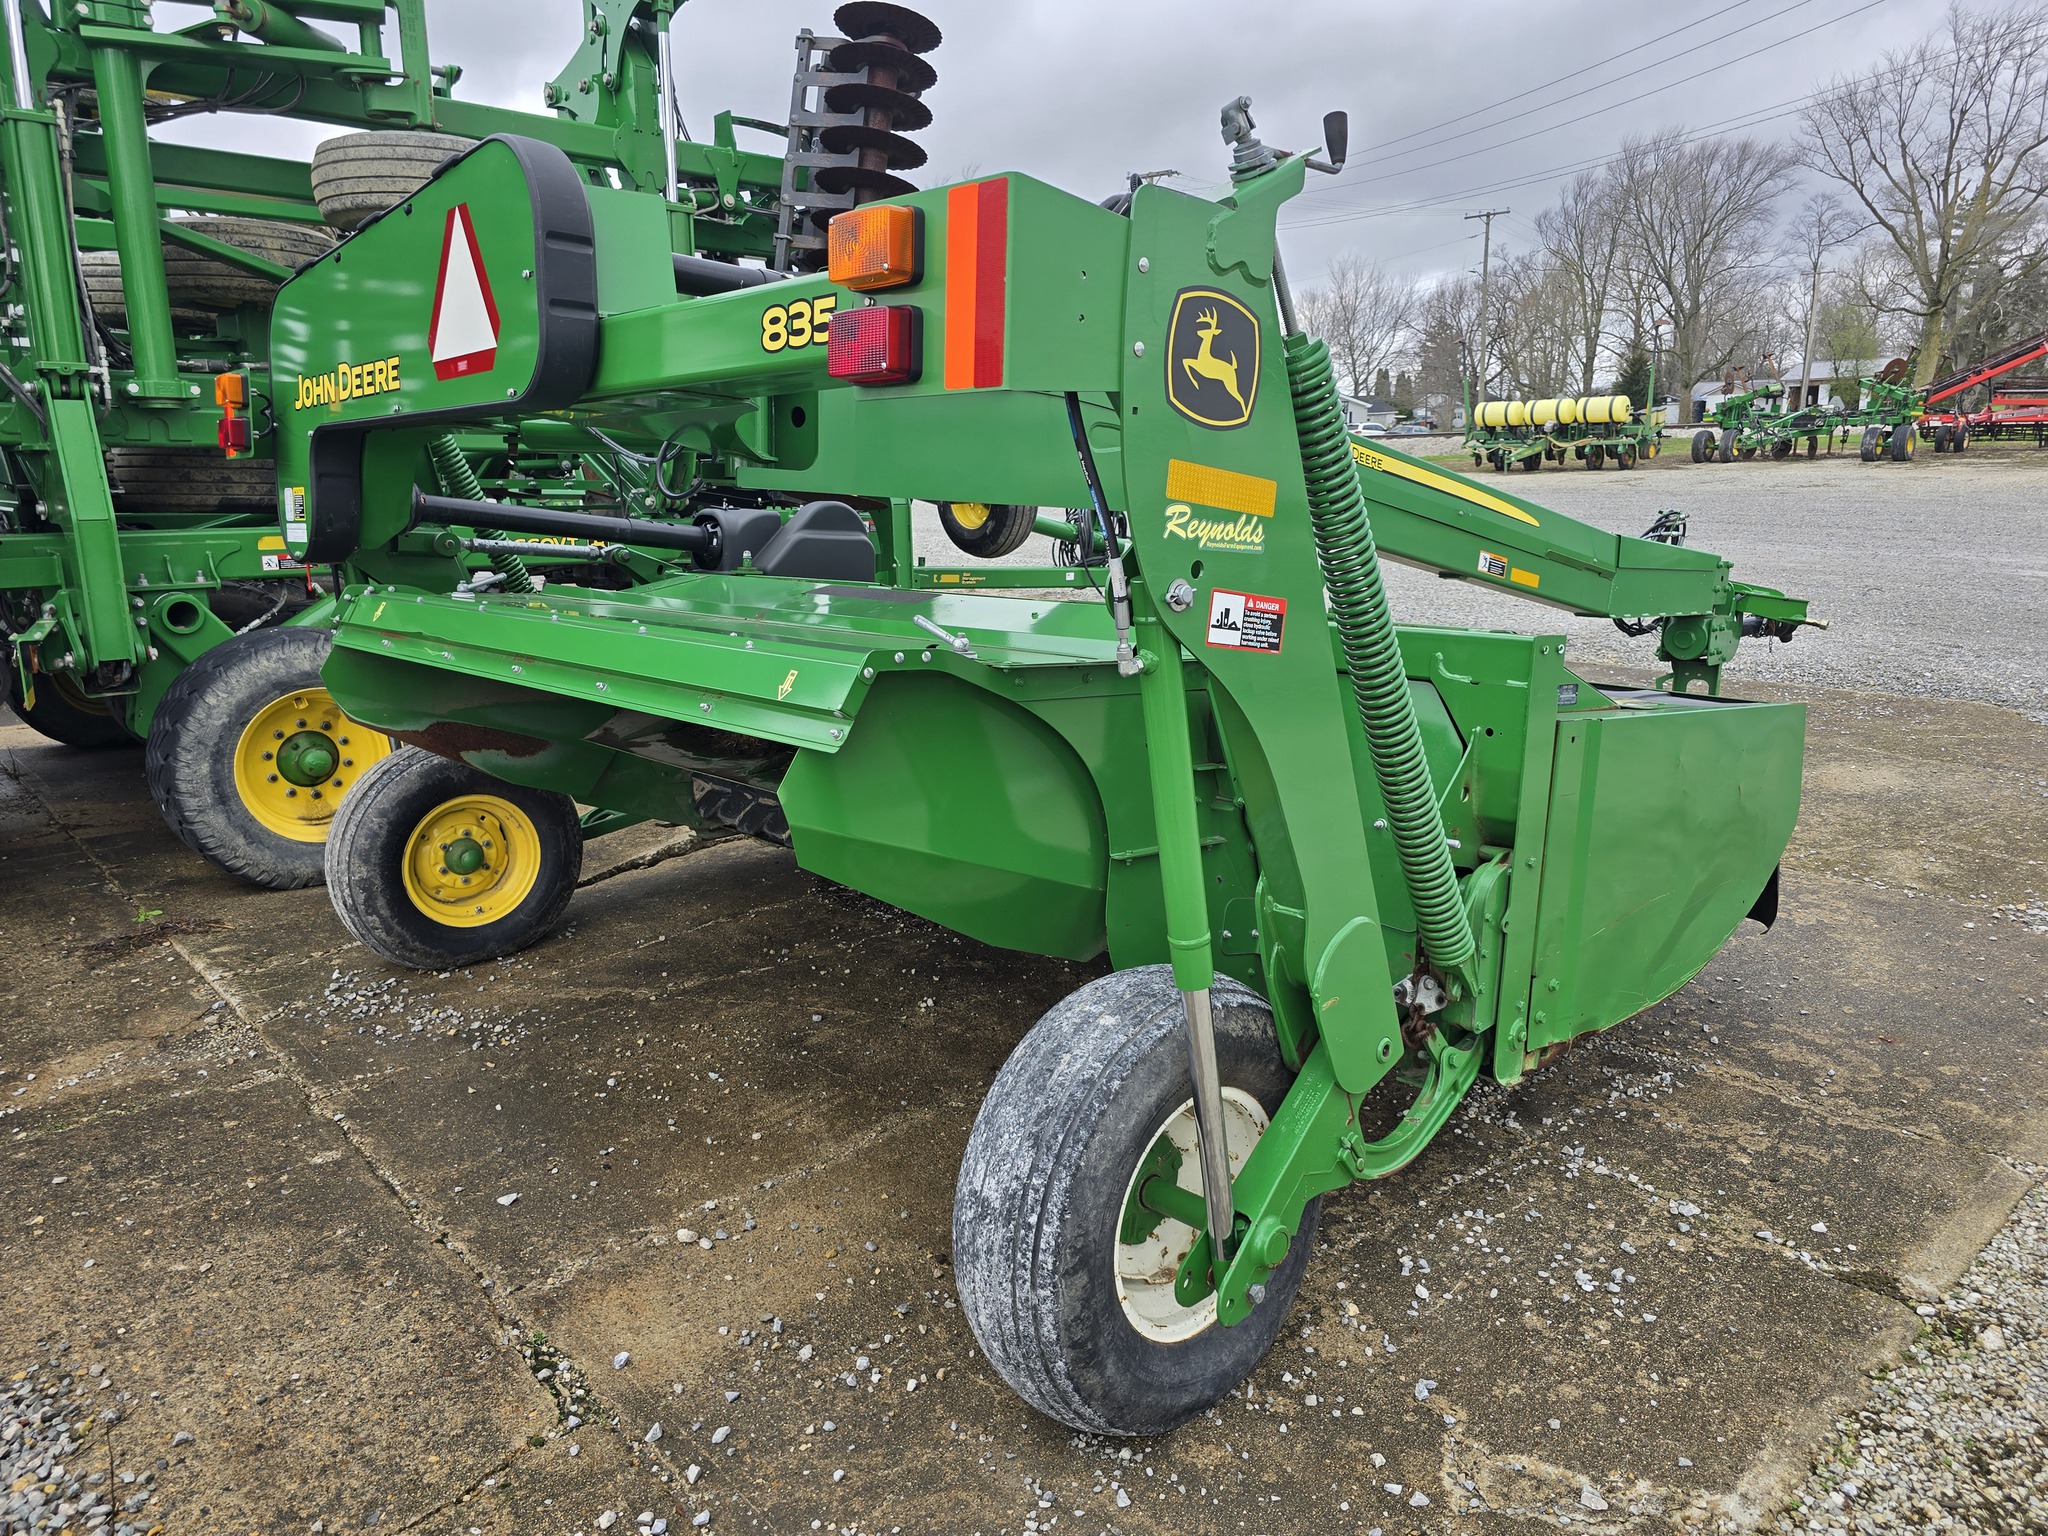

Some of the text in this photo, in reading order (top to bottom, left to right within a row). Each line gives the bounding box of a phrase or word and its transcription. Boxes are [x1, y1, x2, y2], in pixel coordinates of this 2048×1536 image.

[762, 293, 836, 353] 835
[295, 355, 400, 410] JOHN DEERE
[1352, 447, 1383, 469] DEERE
[1163, 503, 1265, 549] Reynolds
[1256, 601, 1280, 611] DANGER
